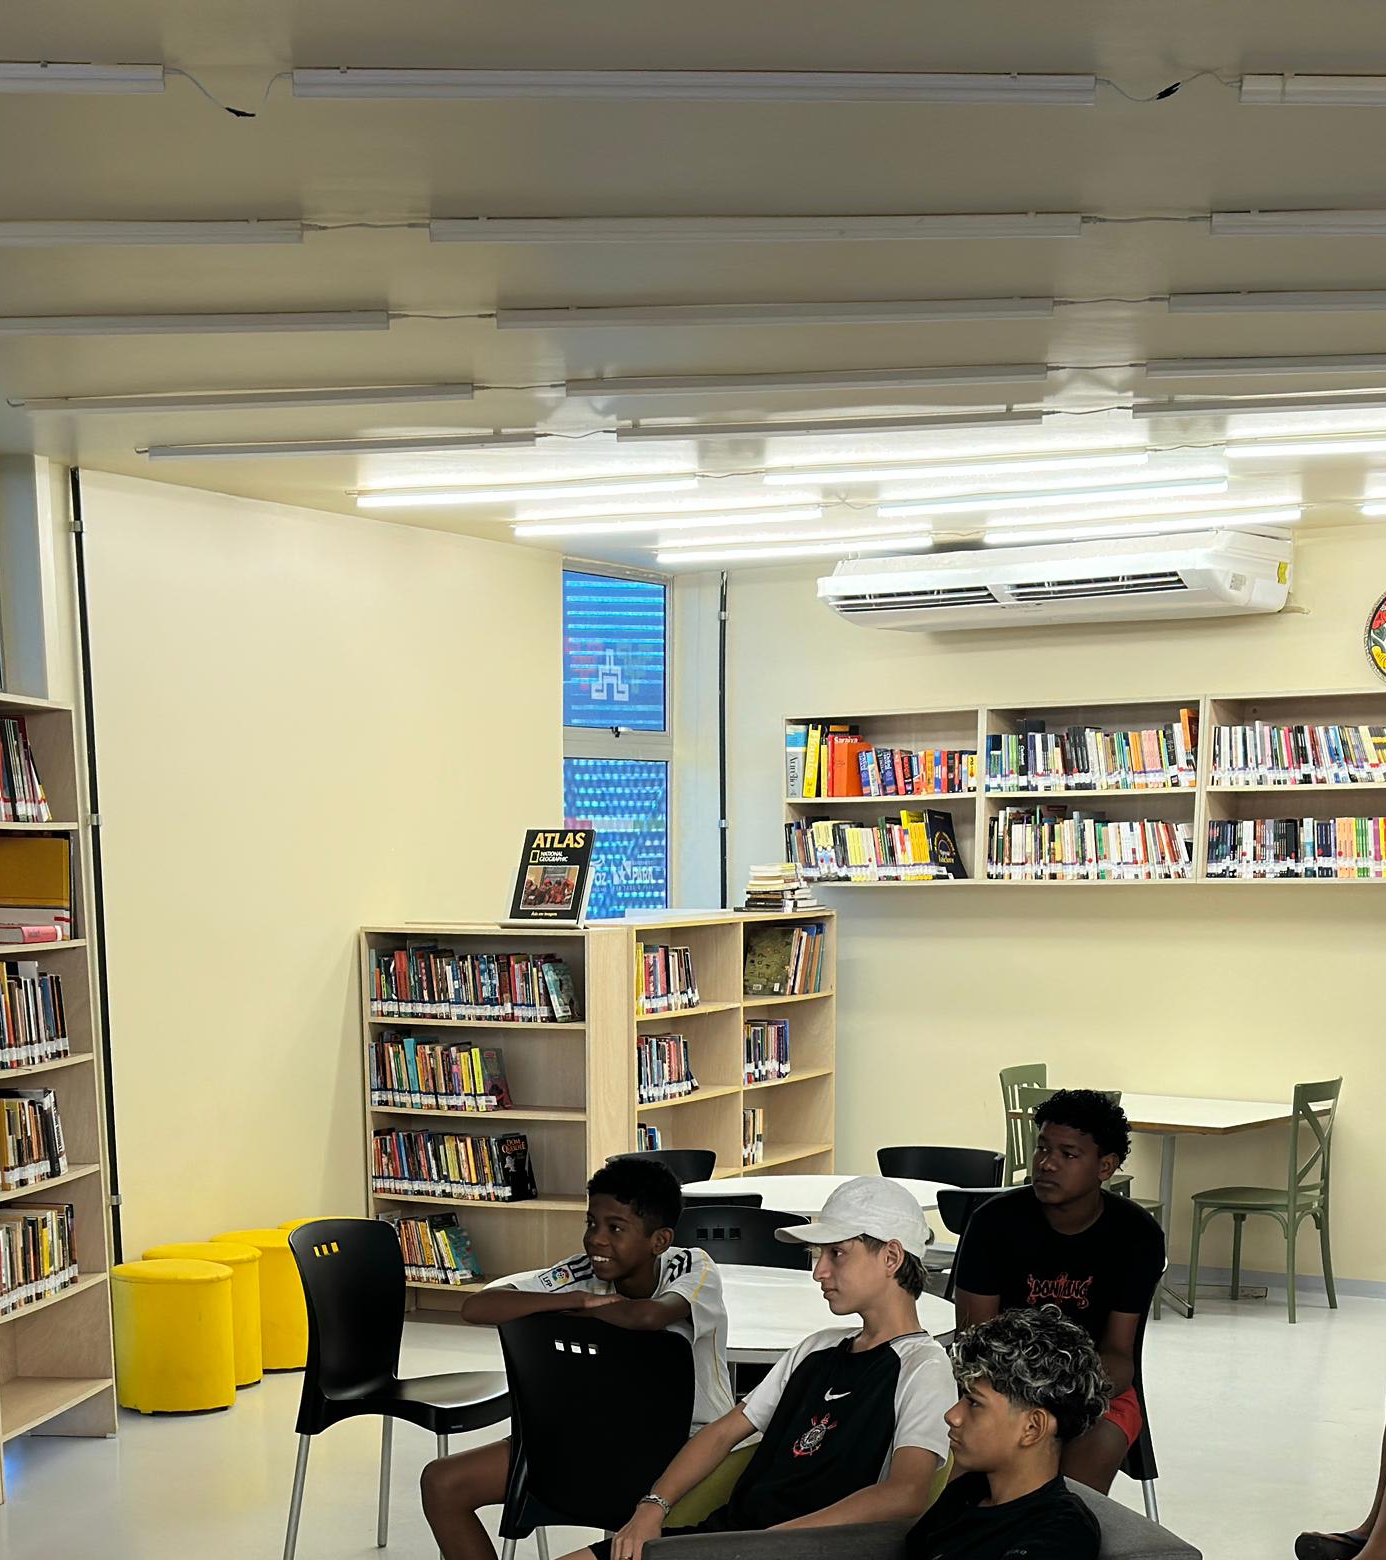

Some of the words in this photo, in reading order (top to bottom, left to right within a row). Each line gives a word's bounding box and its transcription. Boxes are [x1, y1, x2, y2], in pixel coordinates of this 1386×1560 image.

[834, 736, 858, 744] Saraiva
[532, 833, 585, 848] ATLAS
[543, 1277, 552, 1287] LFP
